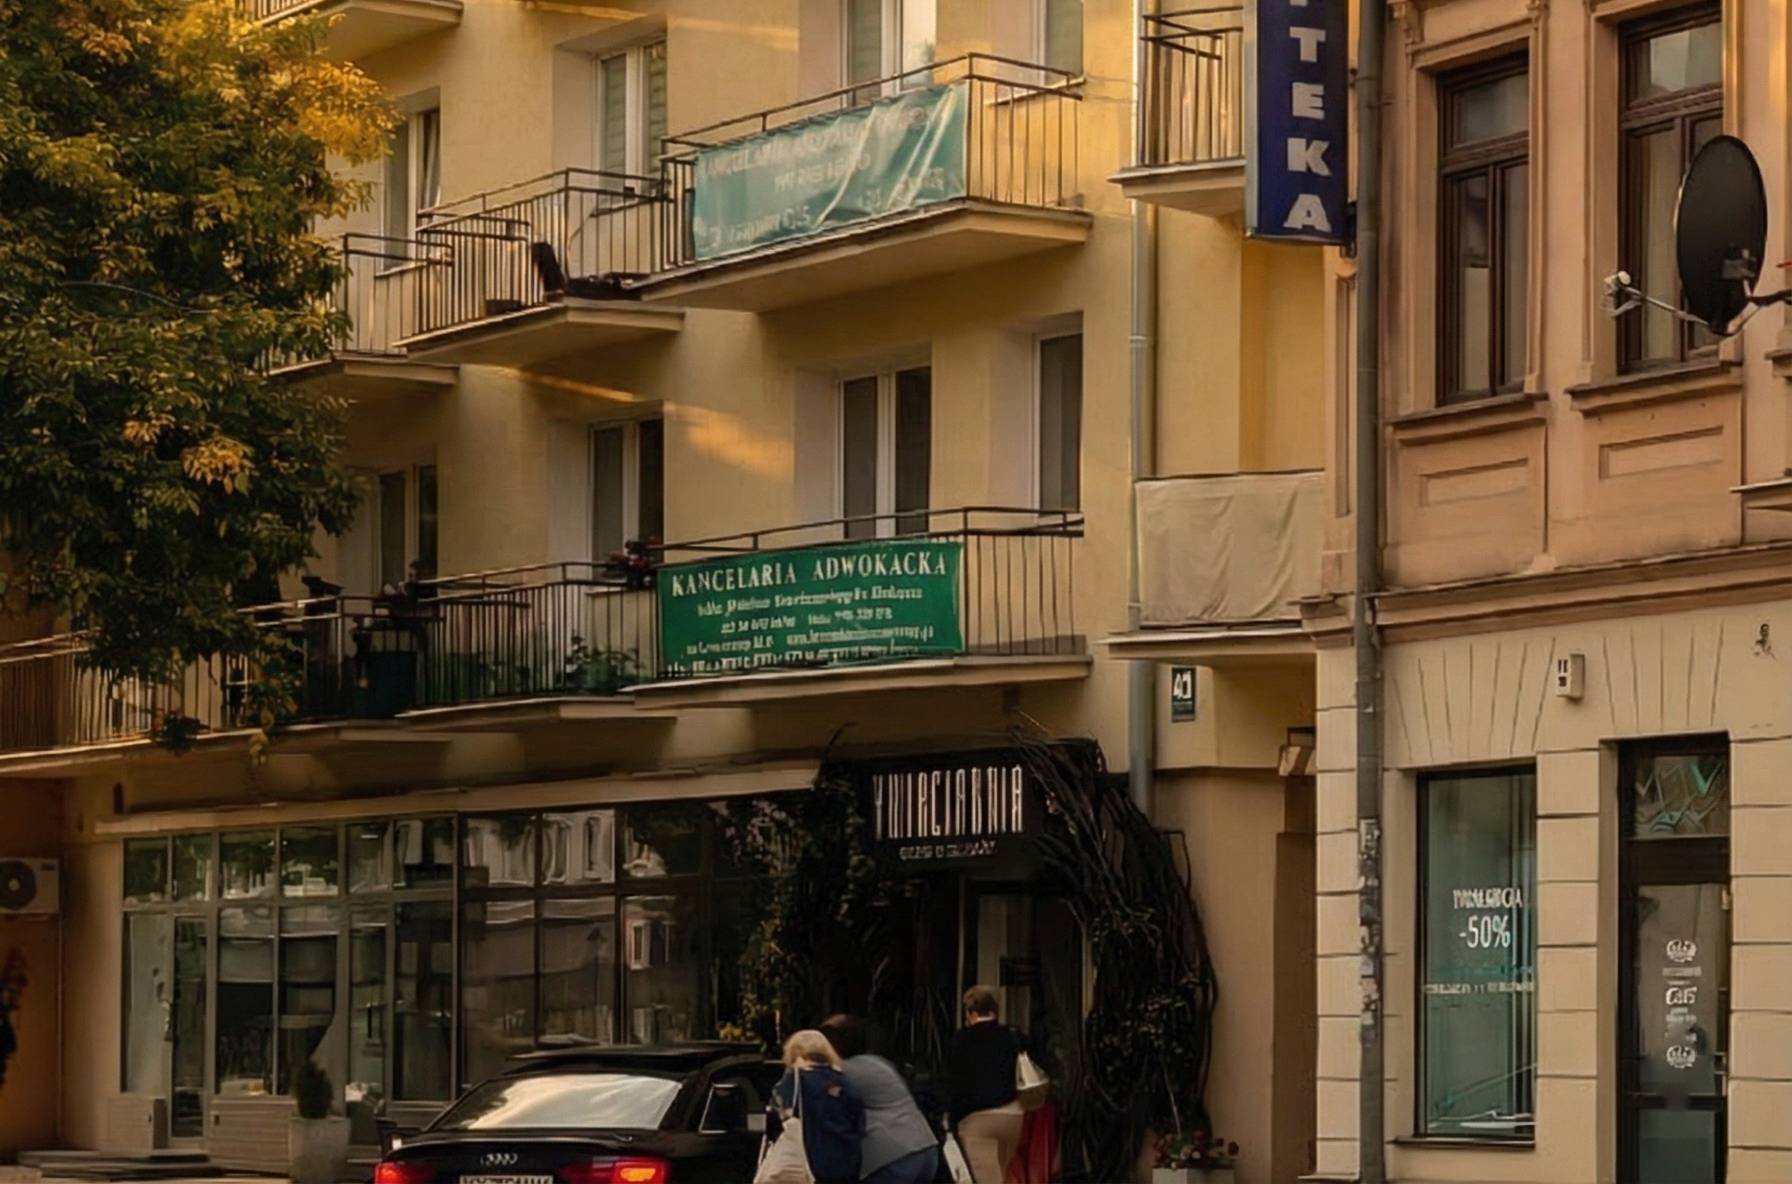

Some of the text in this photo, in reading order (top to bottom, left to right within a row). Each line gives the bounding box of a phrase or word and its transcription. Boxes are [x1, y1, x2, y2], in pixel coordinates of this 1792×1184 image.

[671, 551, 947, 597] KANCELARIA ADWOKACKA
[1459, 915, 1511, 948] -50%
